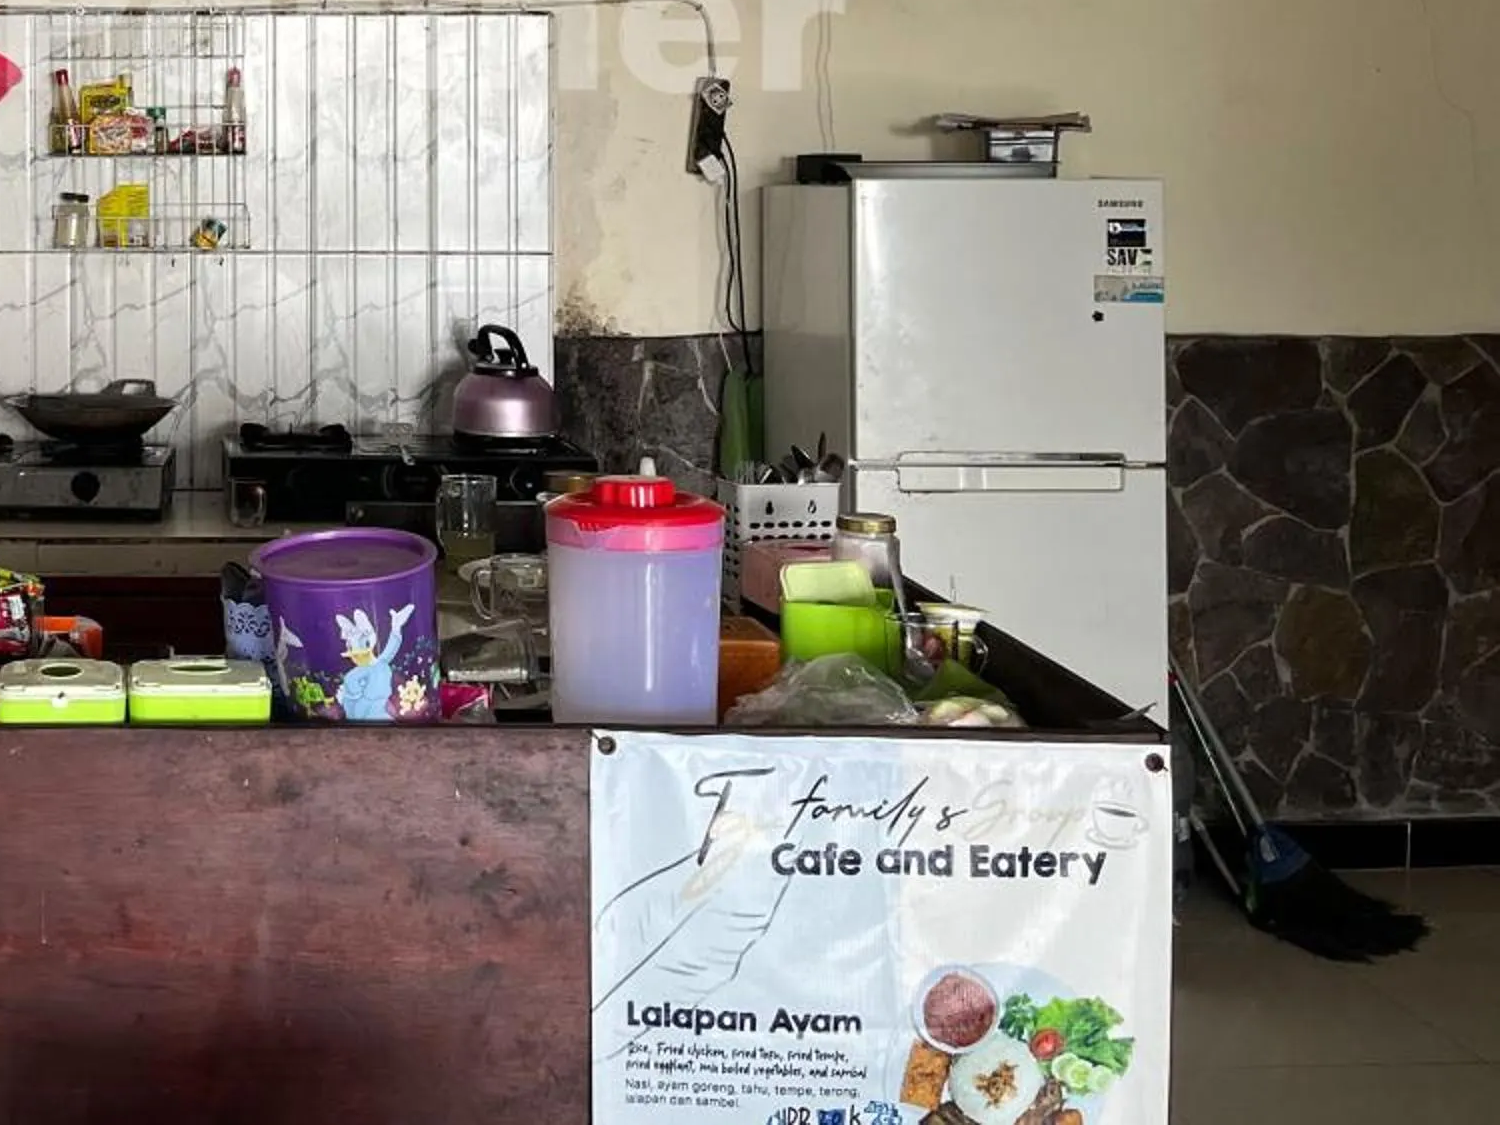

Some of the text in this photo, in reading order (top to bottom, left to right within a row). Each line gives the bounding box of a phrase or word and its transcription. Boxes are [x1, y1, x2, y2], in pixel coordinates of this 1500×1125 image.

[771, 842, 1107, 885] Cafe and Eatery
[627, 1000, 863, 1040] Lalapan Ayam
[657, 1042, 685, 1056] Fried
